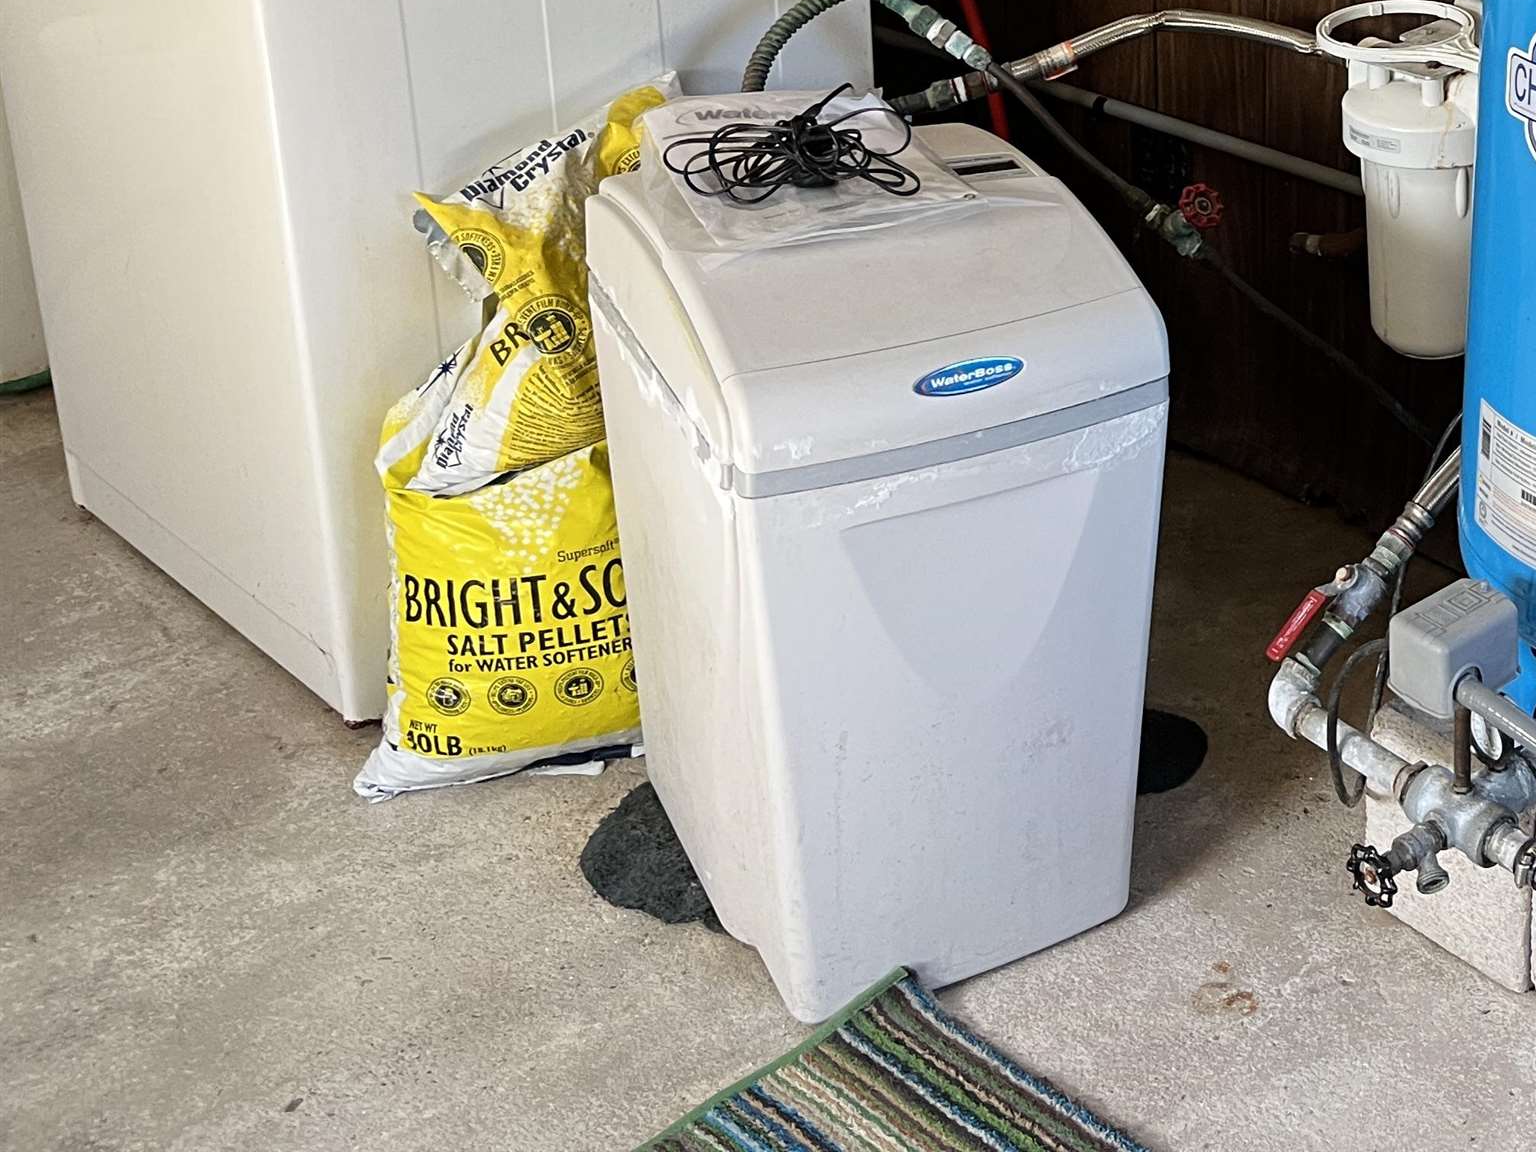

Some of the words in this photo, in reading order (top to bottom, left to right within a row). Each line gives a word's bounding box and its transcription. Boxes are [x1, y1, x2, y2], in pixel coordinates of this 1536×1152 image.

[460, 139, 552, 202] Diamond
[509, 128, 587, 192] Crystal
[931, 363, 1013, 388] WaterBoss
[557, 540, 615, 562] Supersoft
[447, 634, 508, 656] SALT
[519, 613, 630, 653] PELLET
[449, 659, 472, 673] for
[476, 655, 538, 673] WATER
[409, 719, 423, 731] NET
[424, 723, 438, 734] WT
